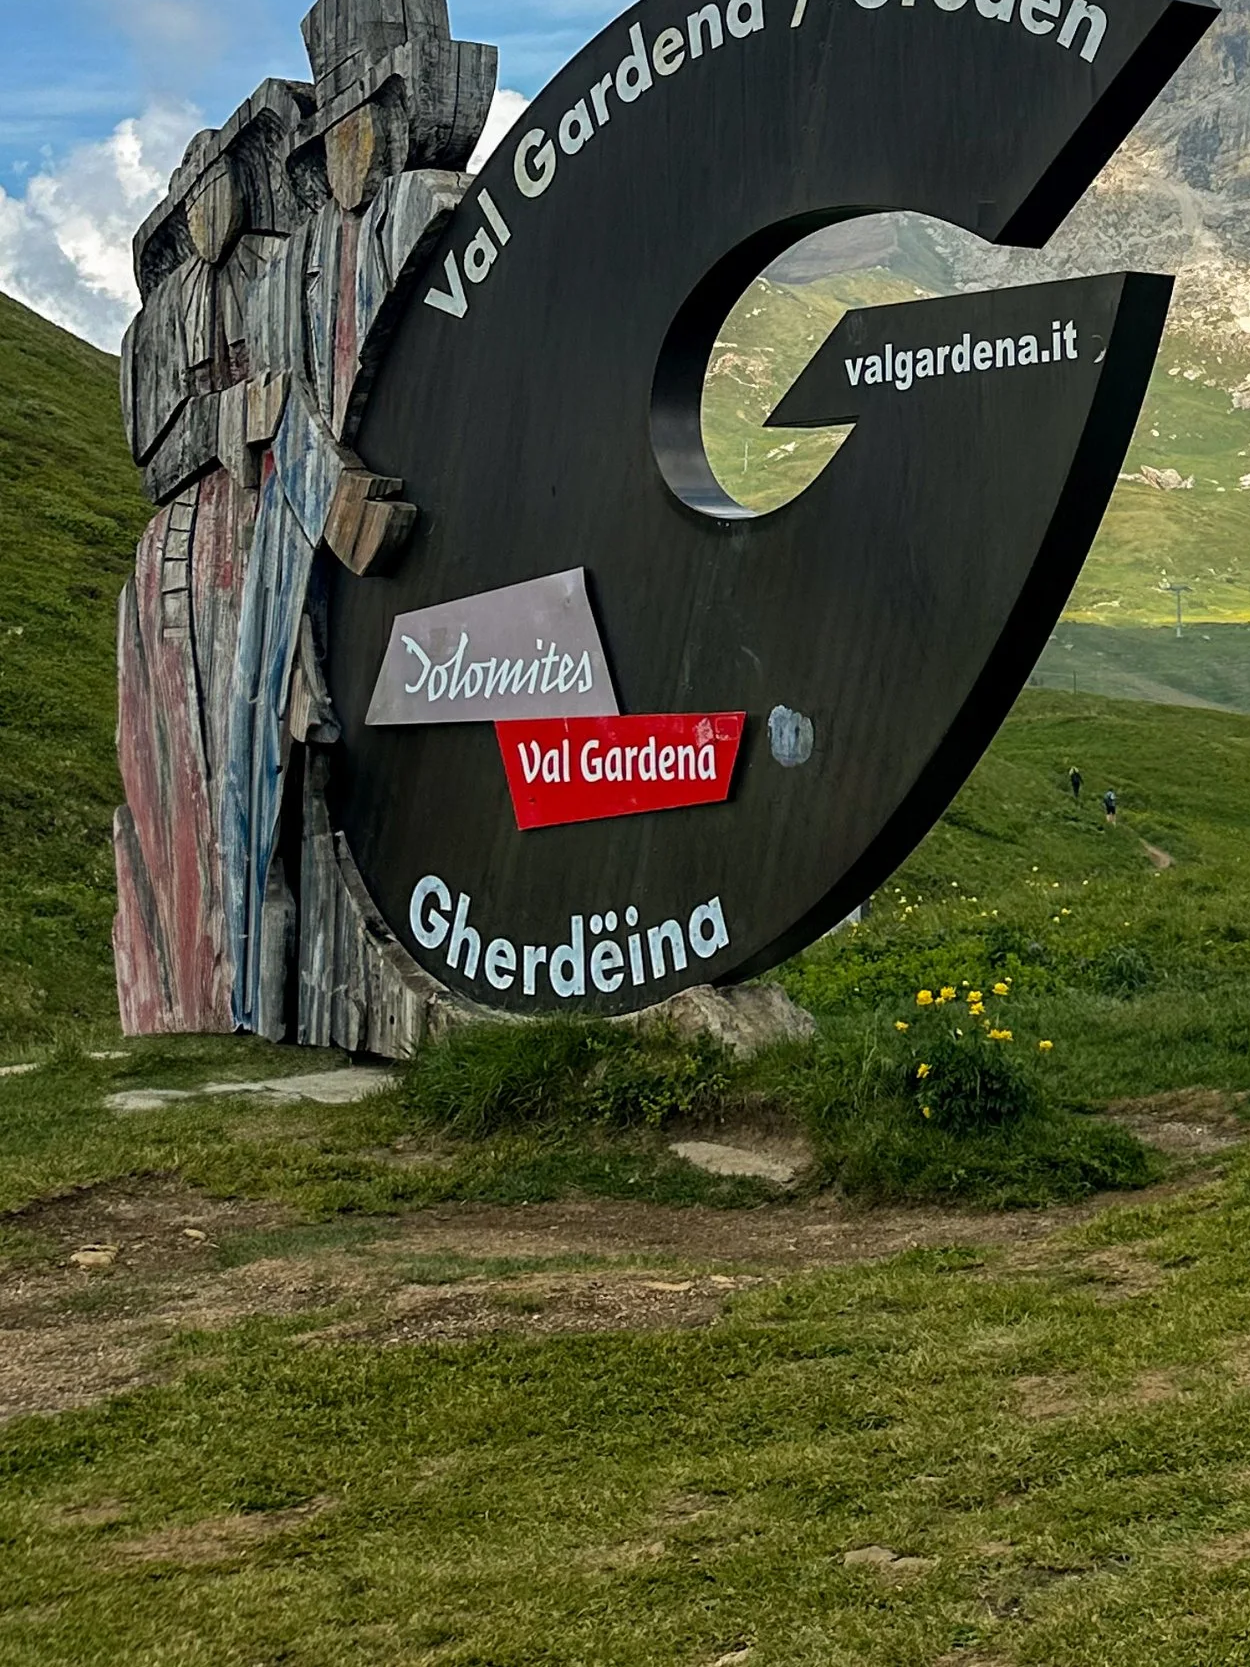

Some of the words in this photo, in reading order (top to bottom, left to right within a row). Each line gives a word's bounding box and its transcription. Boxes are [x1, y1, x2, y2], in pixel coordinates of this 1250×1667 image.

[423, 188, 512, 319] Val
[844, 319, 1079, 391] valgardena.it
[400, 632, 593, 702] Dolomites
[517, 738, 571, 784] Val
[580, 735, 717, 783] Gardena
[409, 874, 731, 999] Gherdëina
